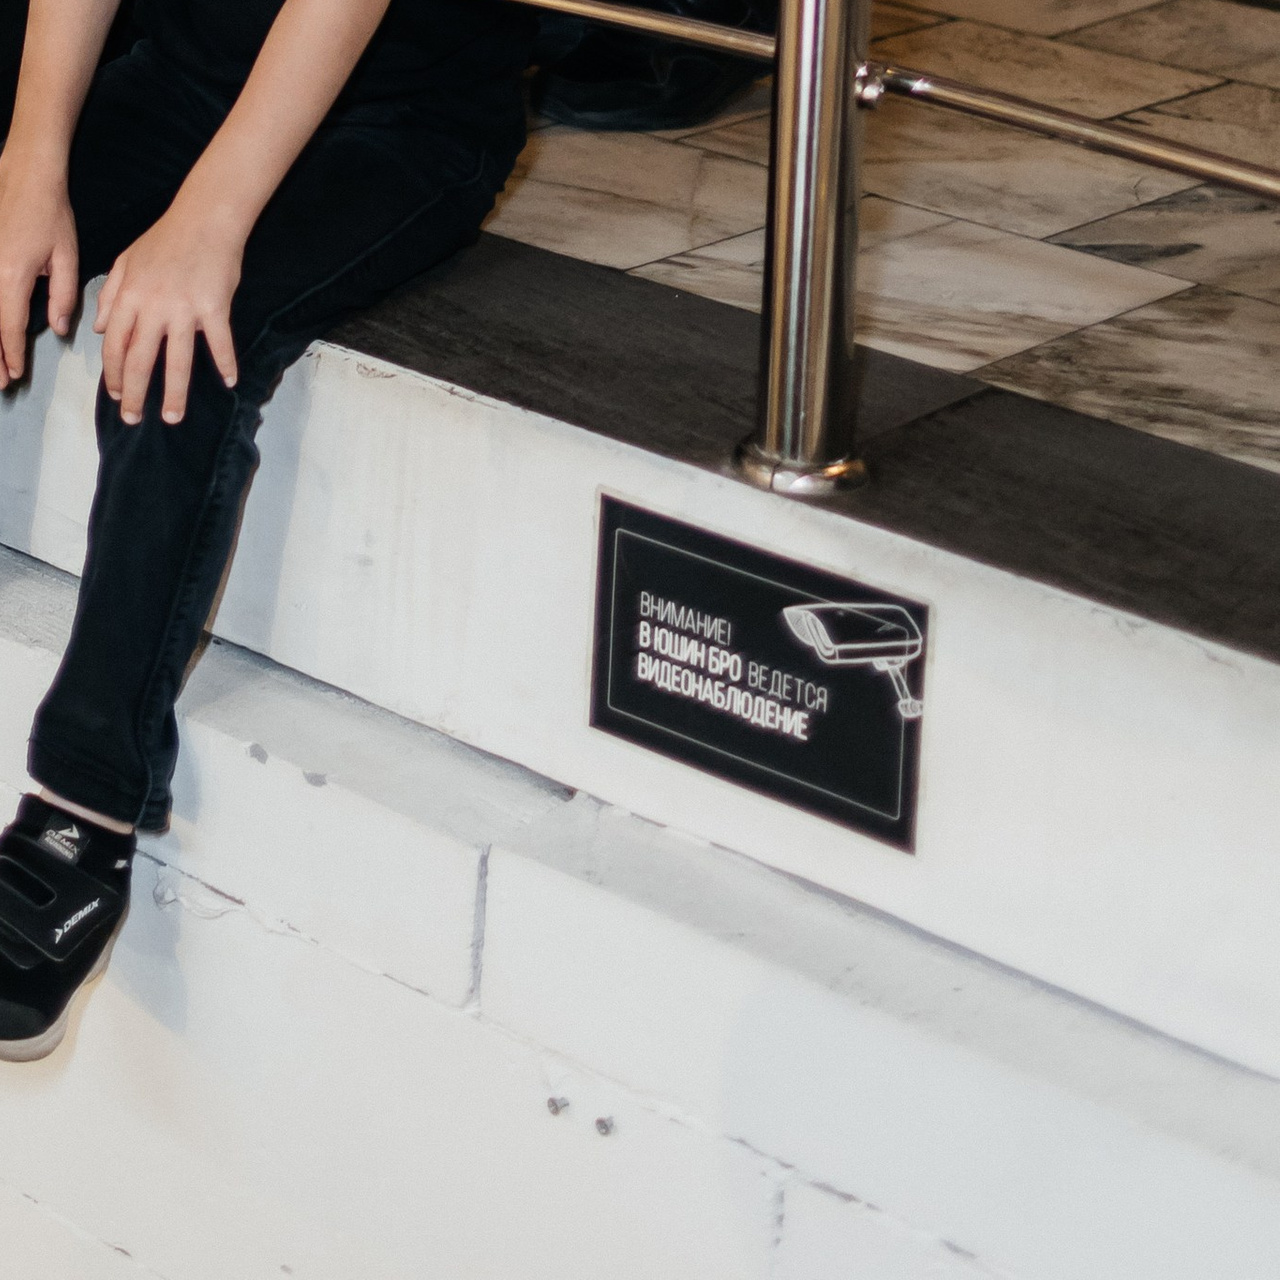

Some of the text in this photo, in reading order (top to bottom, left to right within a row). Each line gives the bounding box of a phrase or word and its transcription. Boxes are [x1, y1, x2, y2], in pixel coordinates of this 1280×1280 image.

[640, 590, 732, 646] ВНИМАНИЕ!
[637, 651, 809, 741] ВИДЕОНАБЛЮДЕНИЕ
[639, 620, 828, 713] В ЮШИН БРО ВЕДЕТСЯ
[63, 897, 100, 934] DEMIX
